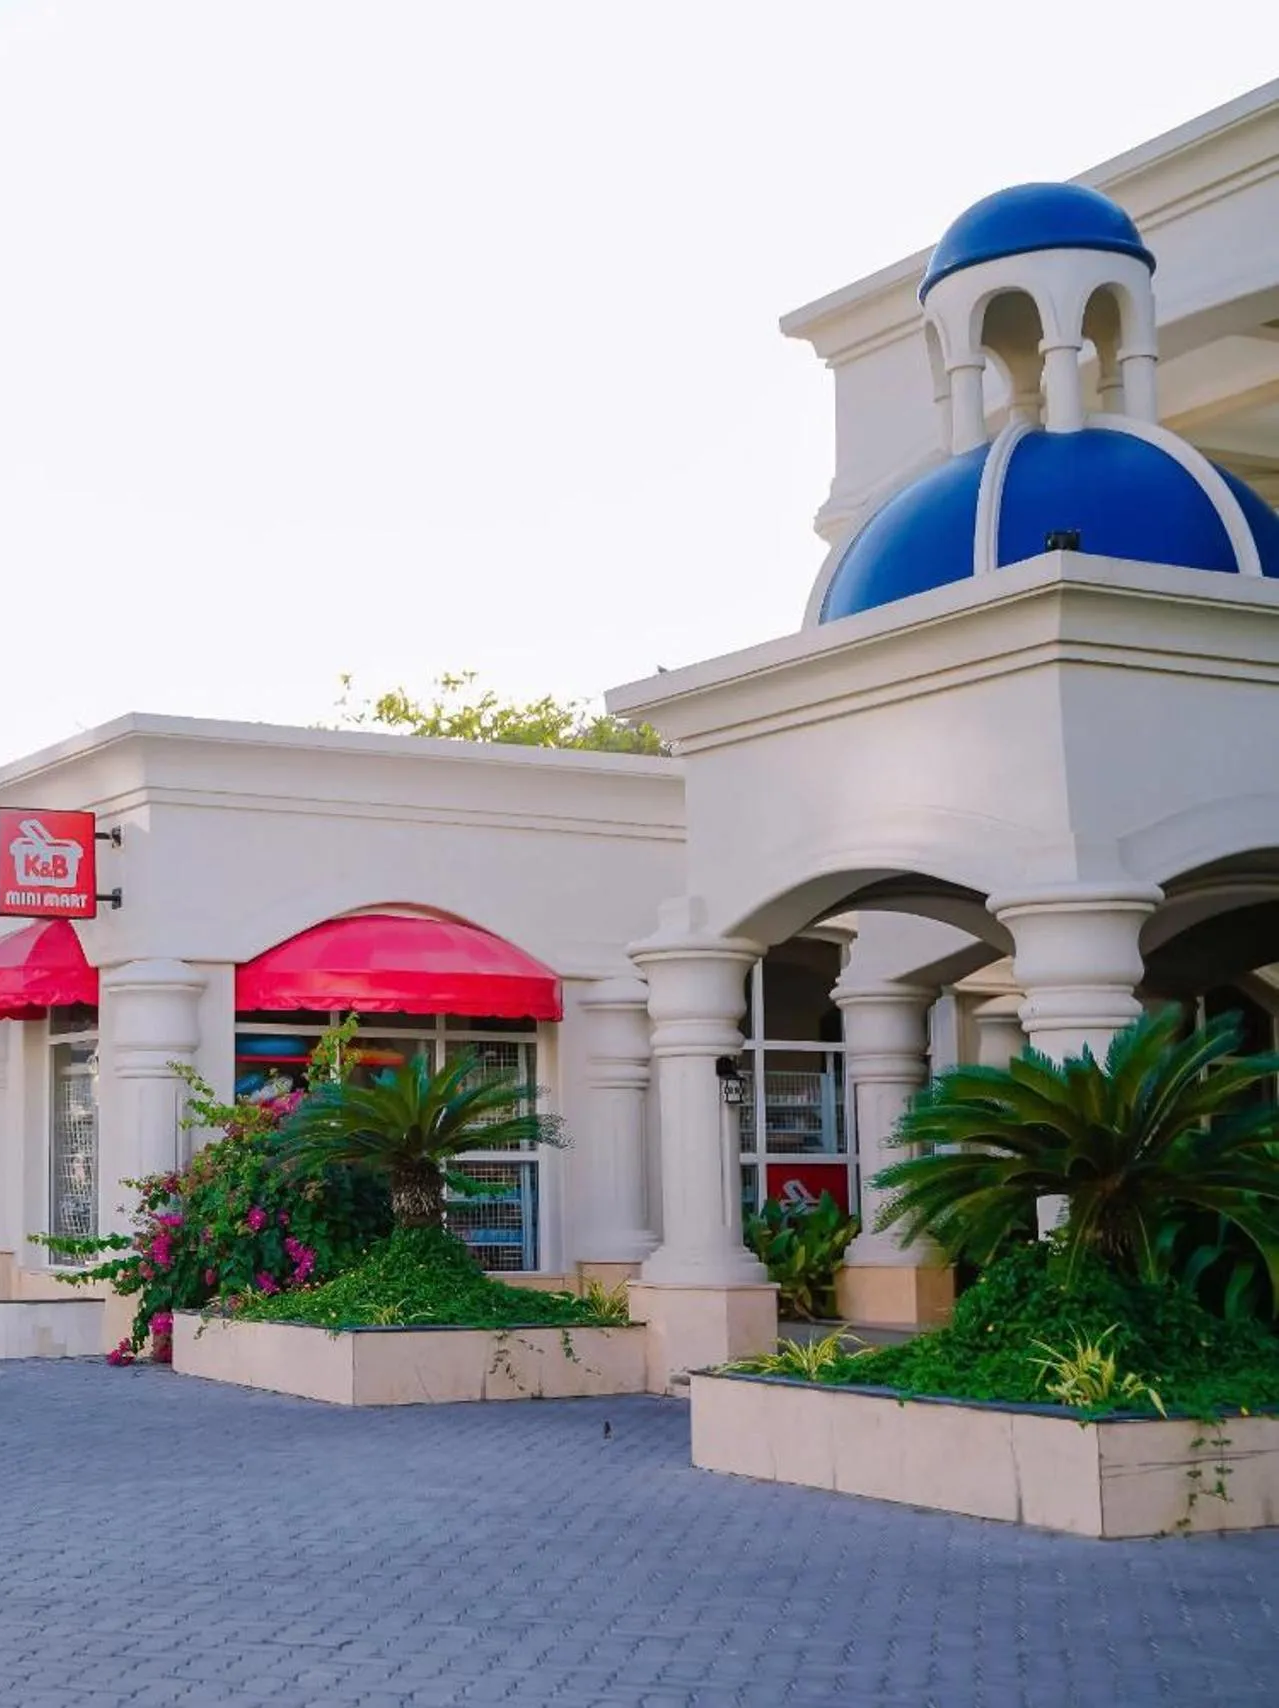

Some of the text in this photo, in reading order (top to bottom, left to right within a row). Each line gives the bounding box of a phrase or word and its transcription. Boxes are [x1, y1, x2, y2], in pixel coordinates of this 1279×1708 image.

[24, 853, 69, 879] K&B
[5, 891, 87, 908] MINI MART
